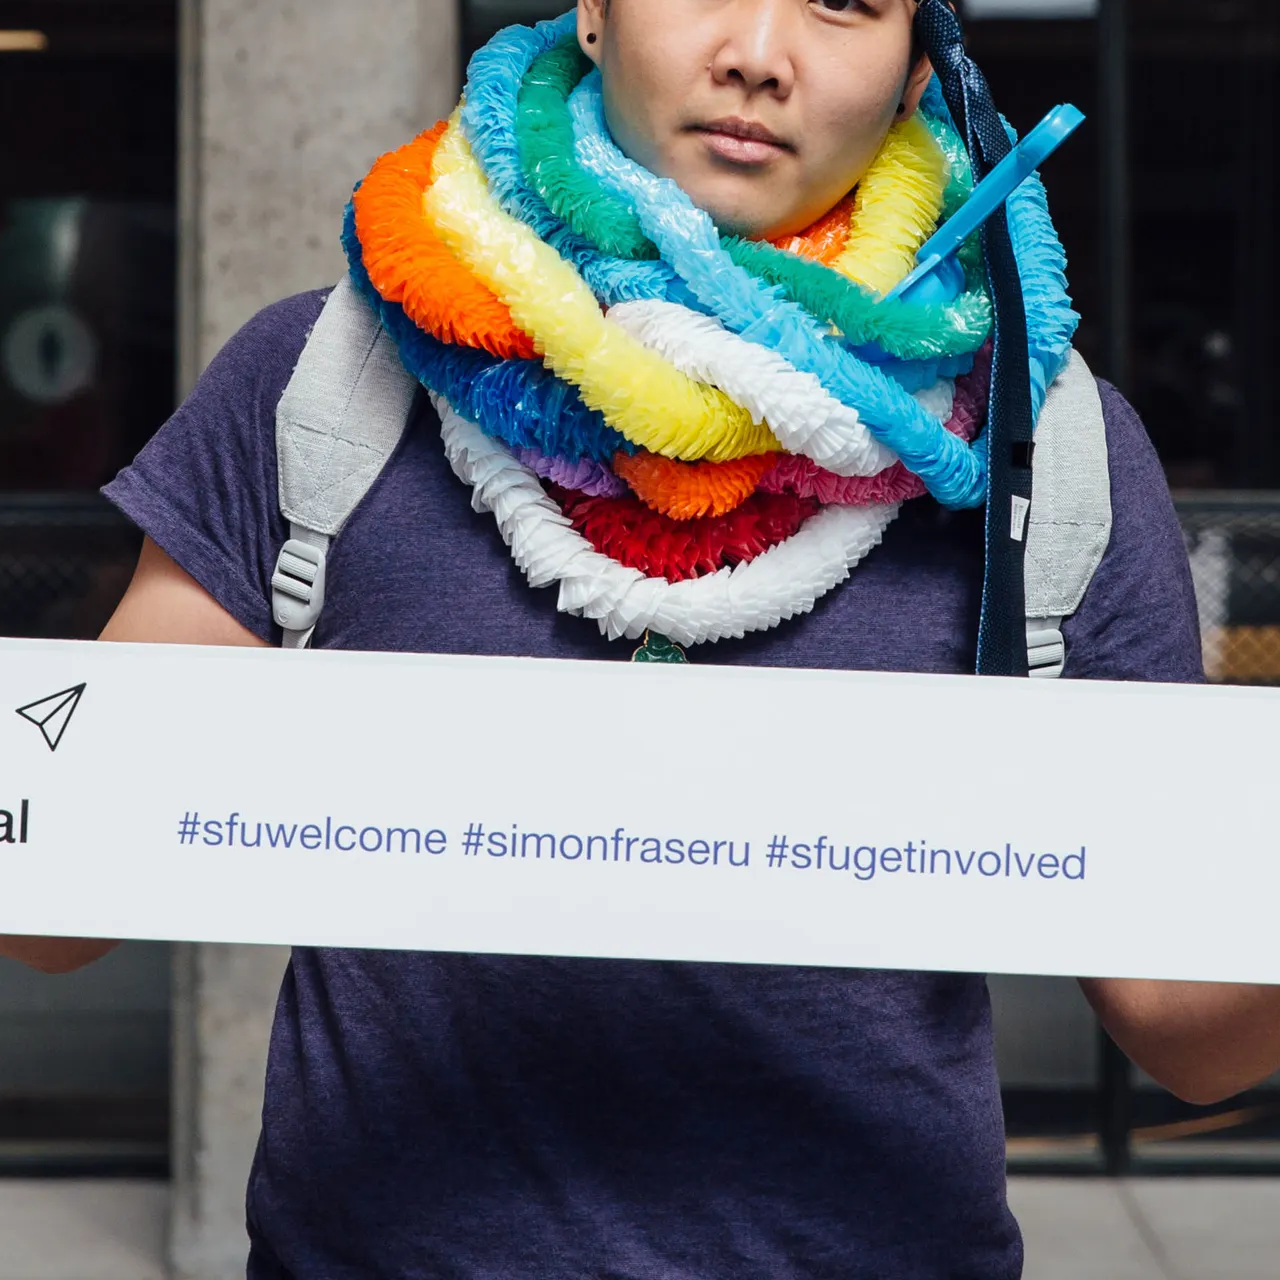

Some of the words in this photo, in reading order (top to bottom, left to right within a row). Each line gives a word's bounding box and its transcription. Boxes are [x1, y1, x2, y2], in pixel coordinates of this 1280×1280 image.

[177, 811, 447, 855] #sfuwelcome
[461, 822, 750, 867] #simonfraseru
[765, 834, 1086, 881] #sfugetinvolved
